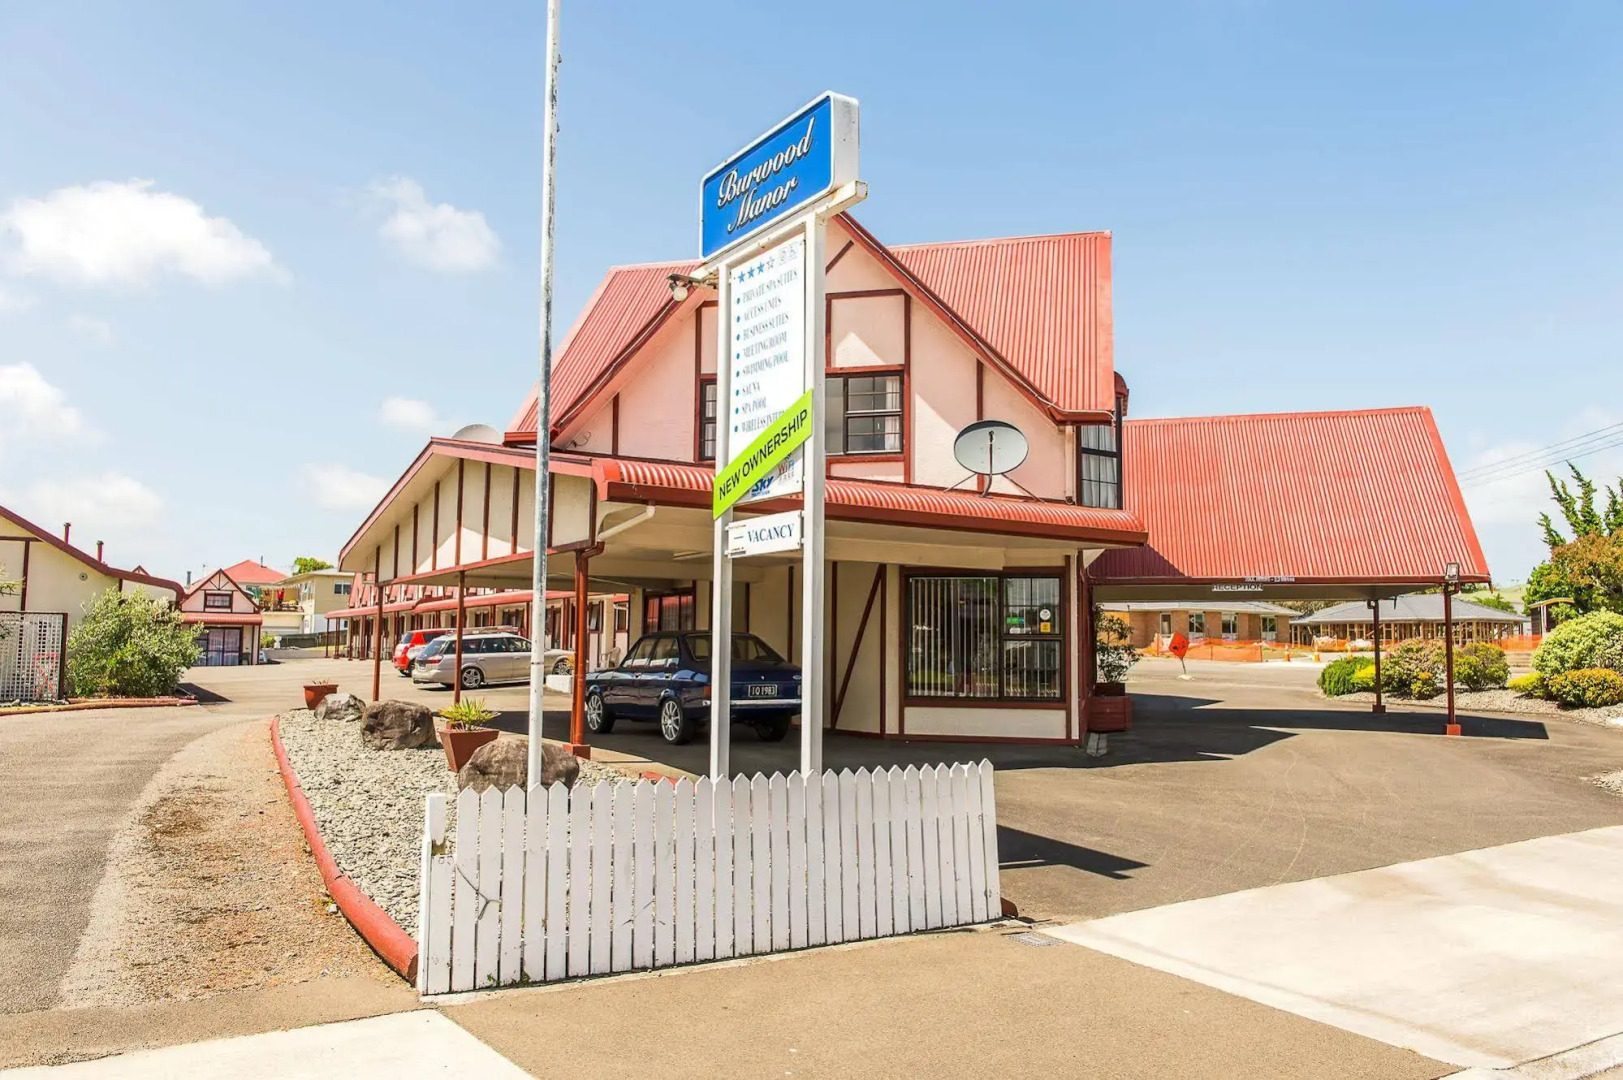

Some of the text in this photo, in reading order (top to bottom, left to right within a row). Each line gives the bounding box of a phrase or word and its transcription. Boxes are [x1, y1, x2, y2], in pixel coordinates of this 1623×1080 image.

[717, 117, 815, 209] Burwood
[727, 176, 798, 234] Manor
[743, 282, 765, 303] PRIVATE
[777, 268, 797, 286] SUITES
[744, 296, 782, 321] ACCESS UNITS
[743, 312, 789, 341] BUSINESS SUITES
[743, 331, 787, 358] MEETING ROOM
[742, 350, 788, 375] SWIMMING POOL
[742, 380, 760, 396] SAUNA
[742, 396, 767, 414] SPA POOL
[742, 416, 766, 433] WIRELESS
[719, 409, 808, 501] NEW OWNERSHIP
[747, 523, 795, 543] VACANCY
